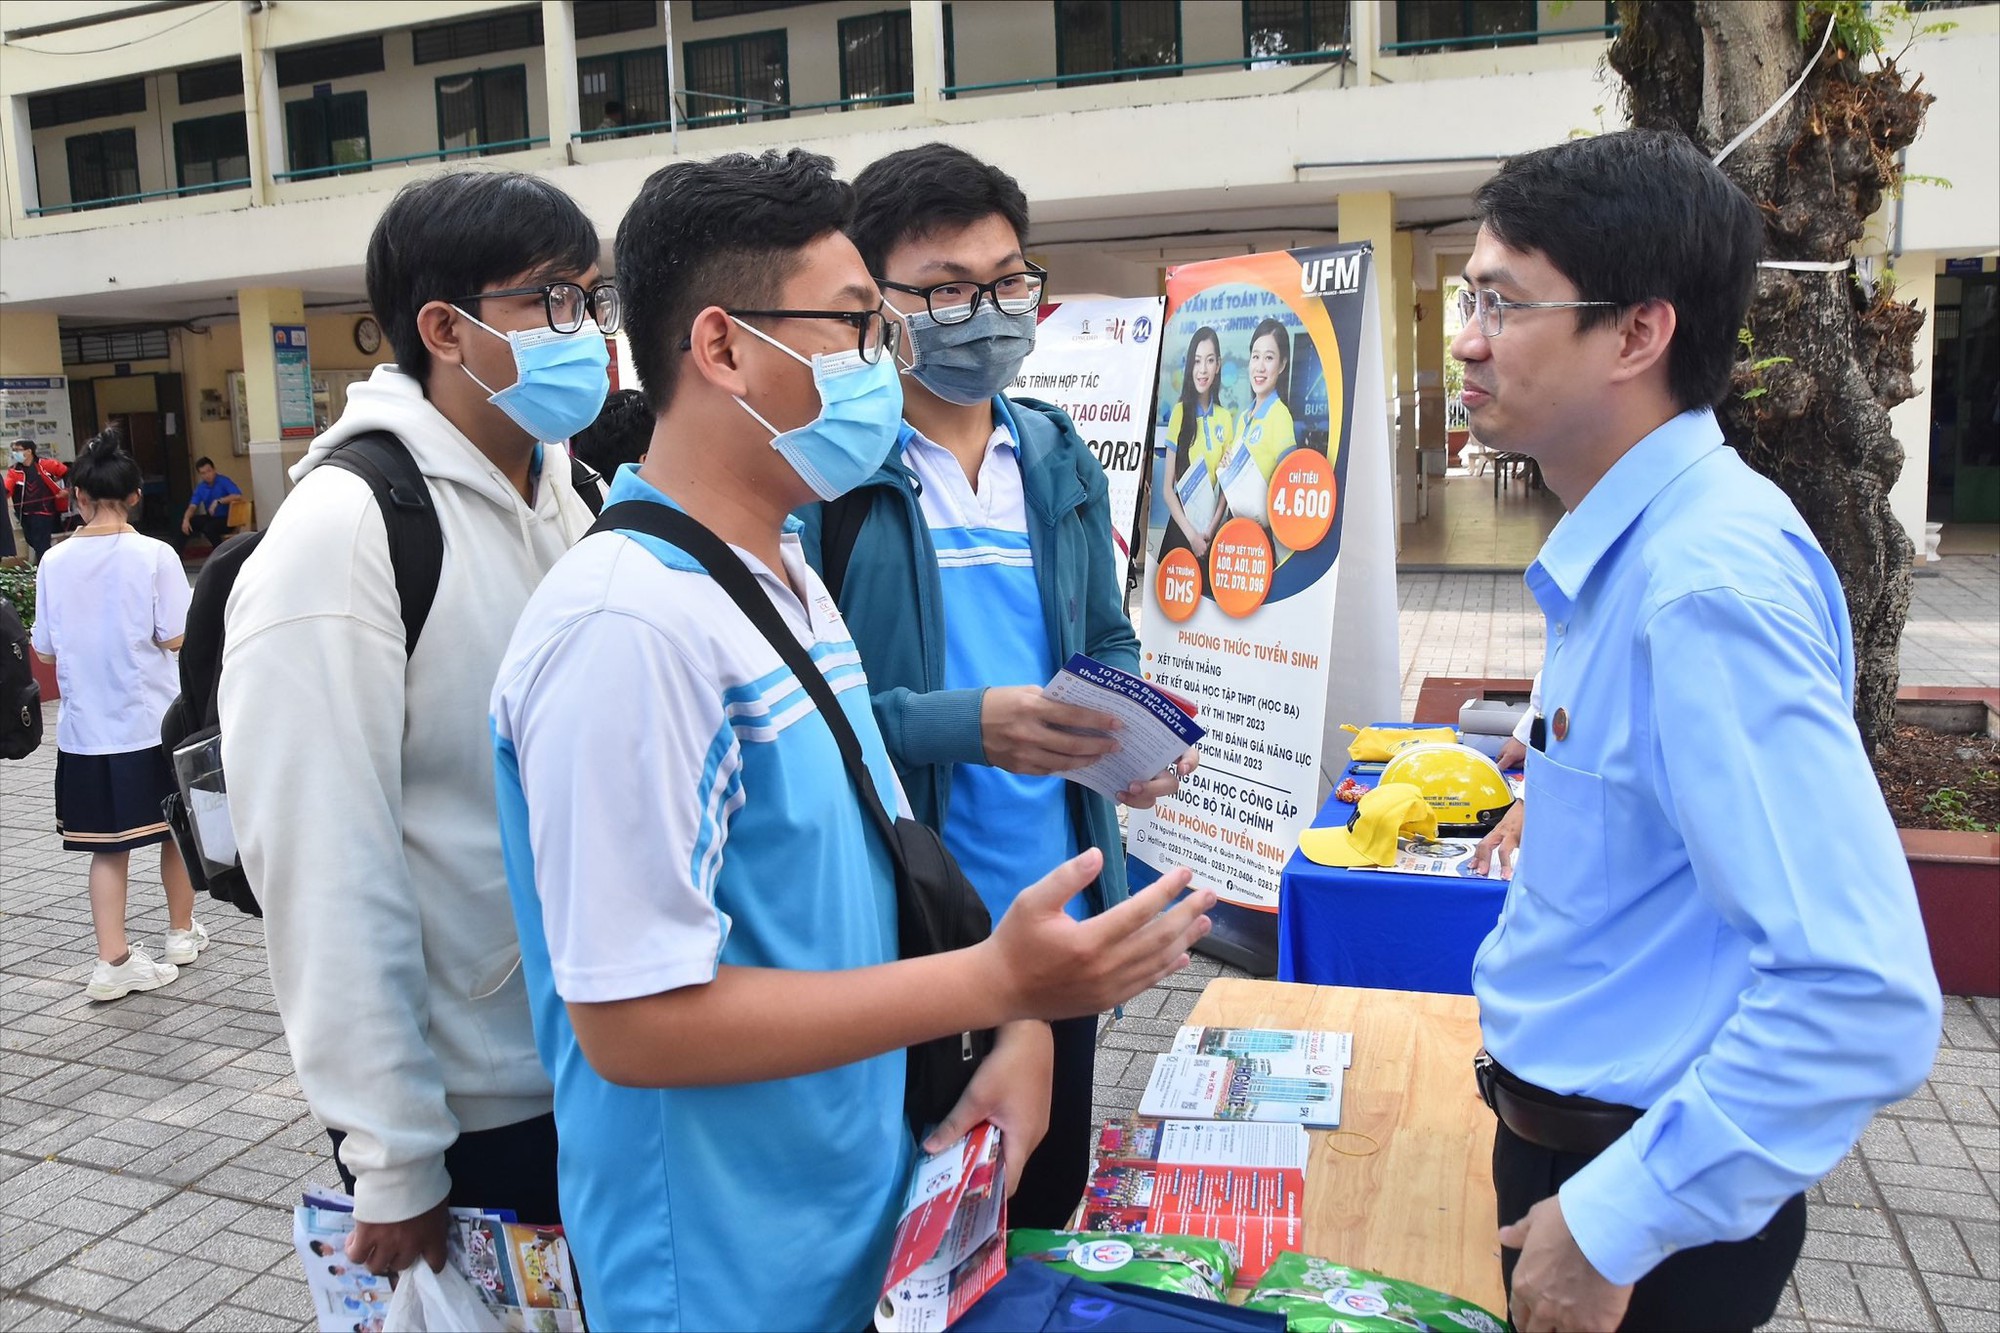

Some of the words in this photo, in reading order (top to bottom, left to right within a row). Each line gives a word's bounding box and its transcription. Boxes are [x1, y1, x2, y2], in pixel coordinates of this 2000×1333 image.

[1301, 255, 1360, 293] UFM
[1029, 372, 1057, 388] TRÌNH
[1058, 374, 1077, 392] HỢP
[1081, 371, 1100, 389] TÁC
[1072, 403, 1098, 427] TẠO
[1100, 399, 1131, 422] GIỮA
[1086, 440, 1142, 472] CORD
[1273, 487, 1331, 518] 4.600
[1165, 577, 1194, 603] DMS
[1157, 651, 1170, 665] XÉT
[1172, 653, 1194, 671] TUYỂN
[1178, 630, 1220, 651] PHƯƠNG
[1223, 637, 1250, 657] THỨC
[1254, 640, 1287, 664] TUYỂN
[1291, 651, 1319, 670] SINH
[1078, 668, 1105, 684] theo
[1105, 680, 1127, 695] học
[1128, 688, 1144, 702] tại
[1144, 698, 1188, 736] HCMUTE
[1098, 667, 1110, 678] 10
[1112, 670, 1125, 683] lý
[1126, 678, 1141, 690] do
[1141, 687, 1162, 705] Bạn
[1161, 702, 1182, 721] nên
[1155, 671, 1169, 686] XÉT
[1202, 684, 1220, 700] HỌC
[1237, 692, 1256, 708] THPT
[1213, 706, 1225, 721] THI
[1226, 710, 1244, 727] THPT
[1246, 717, 1265, 732] 2023
[1211, 729, 1223, 743] THI
[1225, 730, 1248, 749] ĐÁNH
[1249, 736, 1264, 752] GIÁ
[1266, 738, 1293, 762] NĂNG
[1295, 750, 1312, 768] LỰC
[1223, 746, 1242, 765] NĂM
[1243, 754, 1263, 772] 2023
[1193, 774, 1210, 794] ĐẠI
[1213, 780, 1237, 800] HỌC
[1240, 787, 1273, 812] CÔNG
[1276, 799, 1298, 820] LẬP
[1203, 794, 1218, 816] BỘ
[1220, 801, 1236, 819] TÀI
[1239, 806, 1274, 833] CHÍNH
[1154, 803, 1176, 824] VĂN
[1178, 813, 1217, 839] PHÒNG
[1220, 827, 1254, 852] TUYỂN
[1256, 842, 1285, 864] SINH
[1228, 1066, 1253, 1108] HCMUTE
